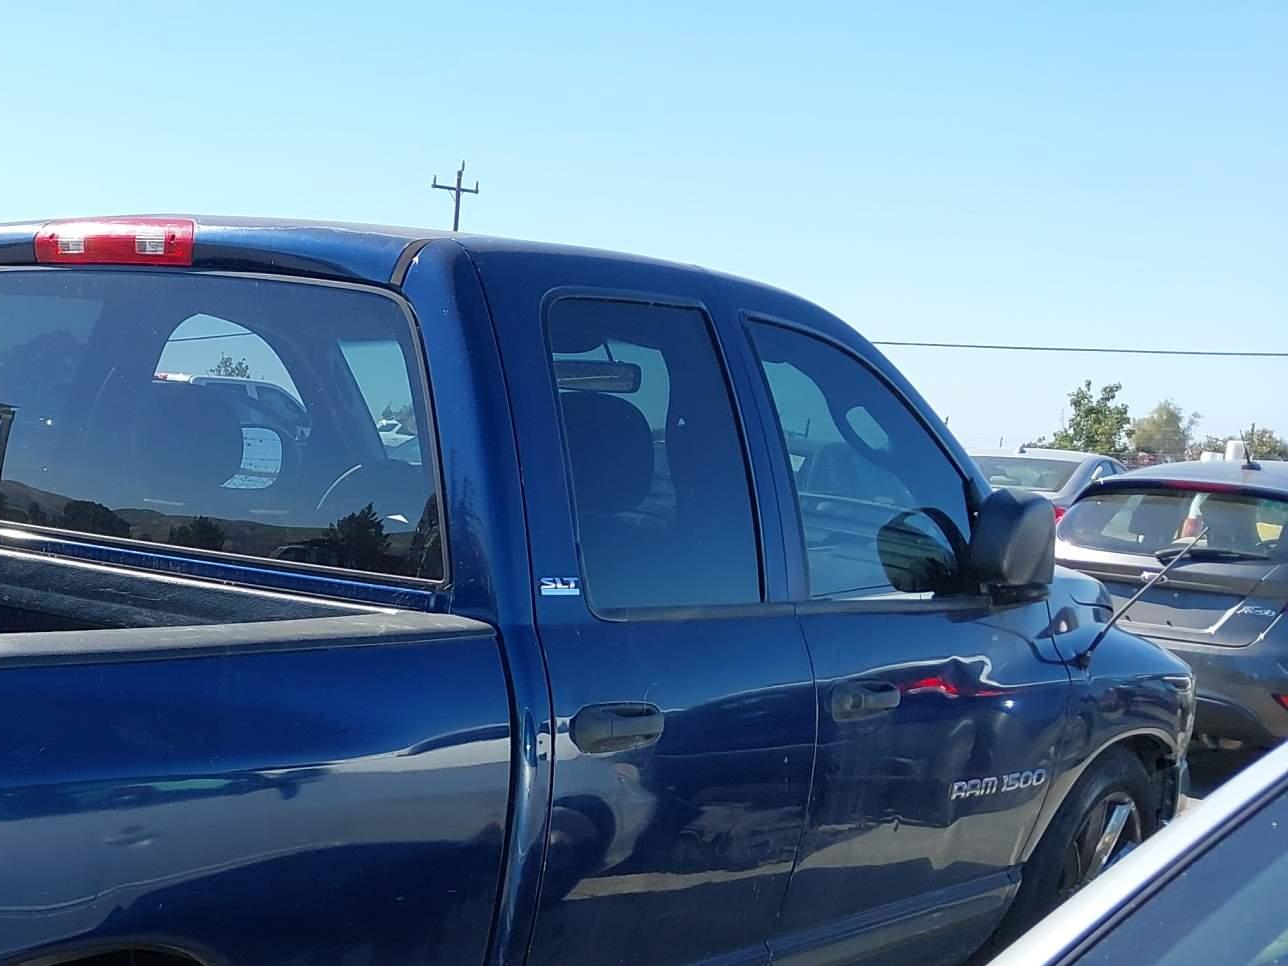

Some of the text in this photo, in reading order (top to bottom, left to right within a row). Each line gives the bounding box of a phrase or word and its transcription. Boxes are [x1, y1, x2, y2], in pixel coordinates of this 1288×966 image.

[540, 577, 579, 589] SLT
[950, 768, 1046, 800] RAM 1500
